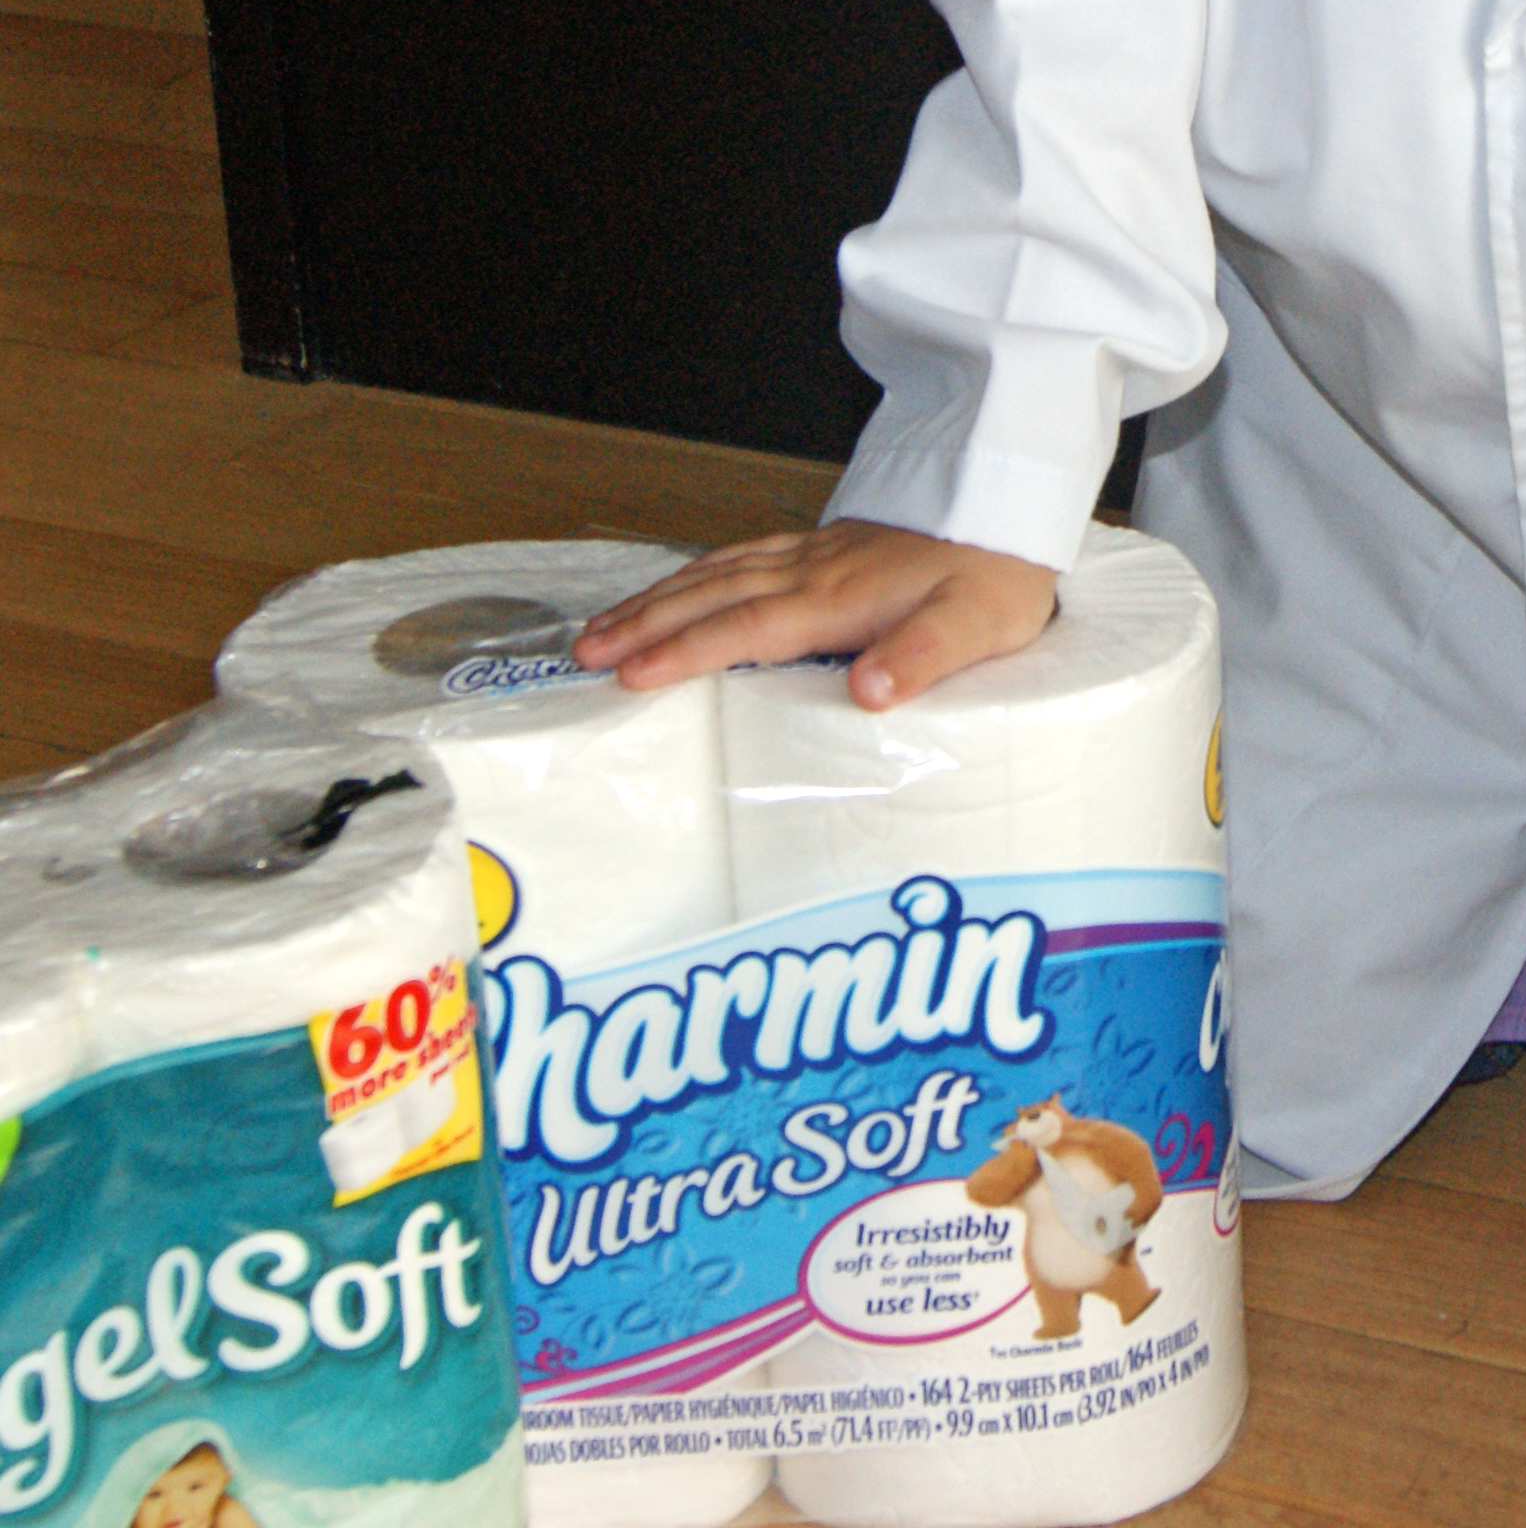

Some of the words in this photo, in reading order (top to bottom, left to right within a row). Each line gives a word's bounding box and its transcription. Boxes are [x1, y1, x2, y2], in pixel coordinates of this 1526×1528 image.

[327, 956, 457, 1082] 60%
[484, 877, 1054, 1170] harmin
[330, 1062, 407, 1115] more
[528, 1153, 765, 1286] Ultra
[770, 1070, 981, 1196] Soft
[855, 1213, 1011, 1246] Irresistibly
[833, 1253, 872, 1277] soft
[906, 1246, 1013, 1268] absorbent
[866, 1294, 914, 1315] use
[920, 1378, 952, 1406] 164
[958, 1376, 1002, 1405] 2-PLY
[1005, 1374, 1057, 1402] SHEETS
[1060, 1369, 1086, 1393] PER
[570, 1437, 625, 1462] DOBLES
[629, 1434, 661, 1457] POR
[665, 1430, 711, 1454] ROLLO
[727, 1426, 768, 1451] TOTAL
[773, 1419, 803, 1448] 6.5
[947, 1409, 973, 1437] 9.9
[978, 1419, 1000, 1436] cm
[1016, 1404, 1048, 1432] 10.1
[1053, 1411, 1074, 1428] cm
